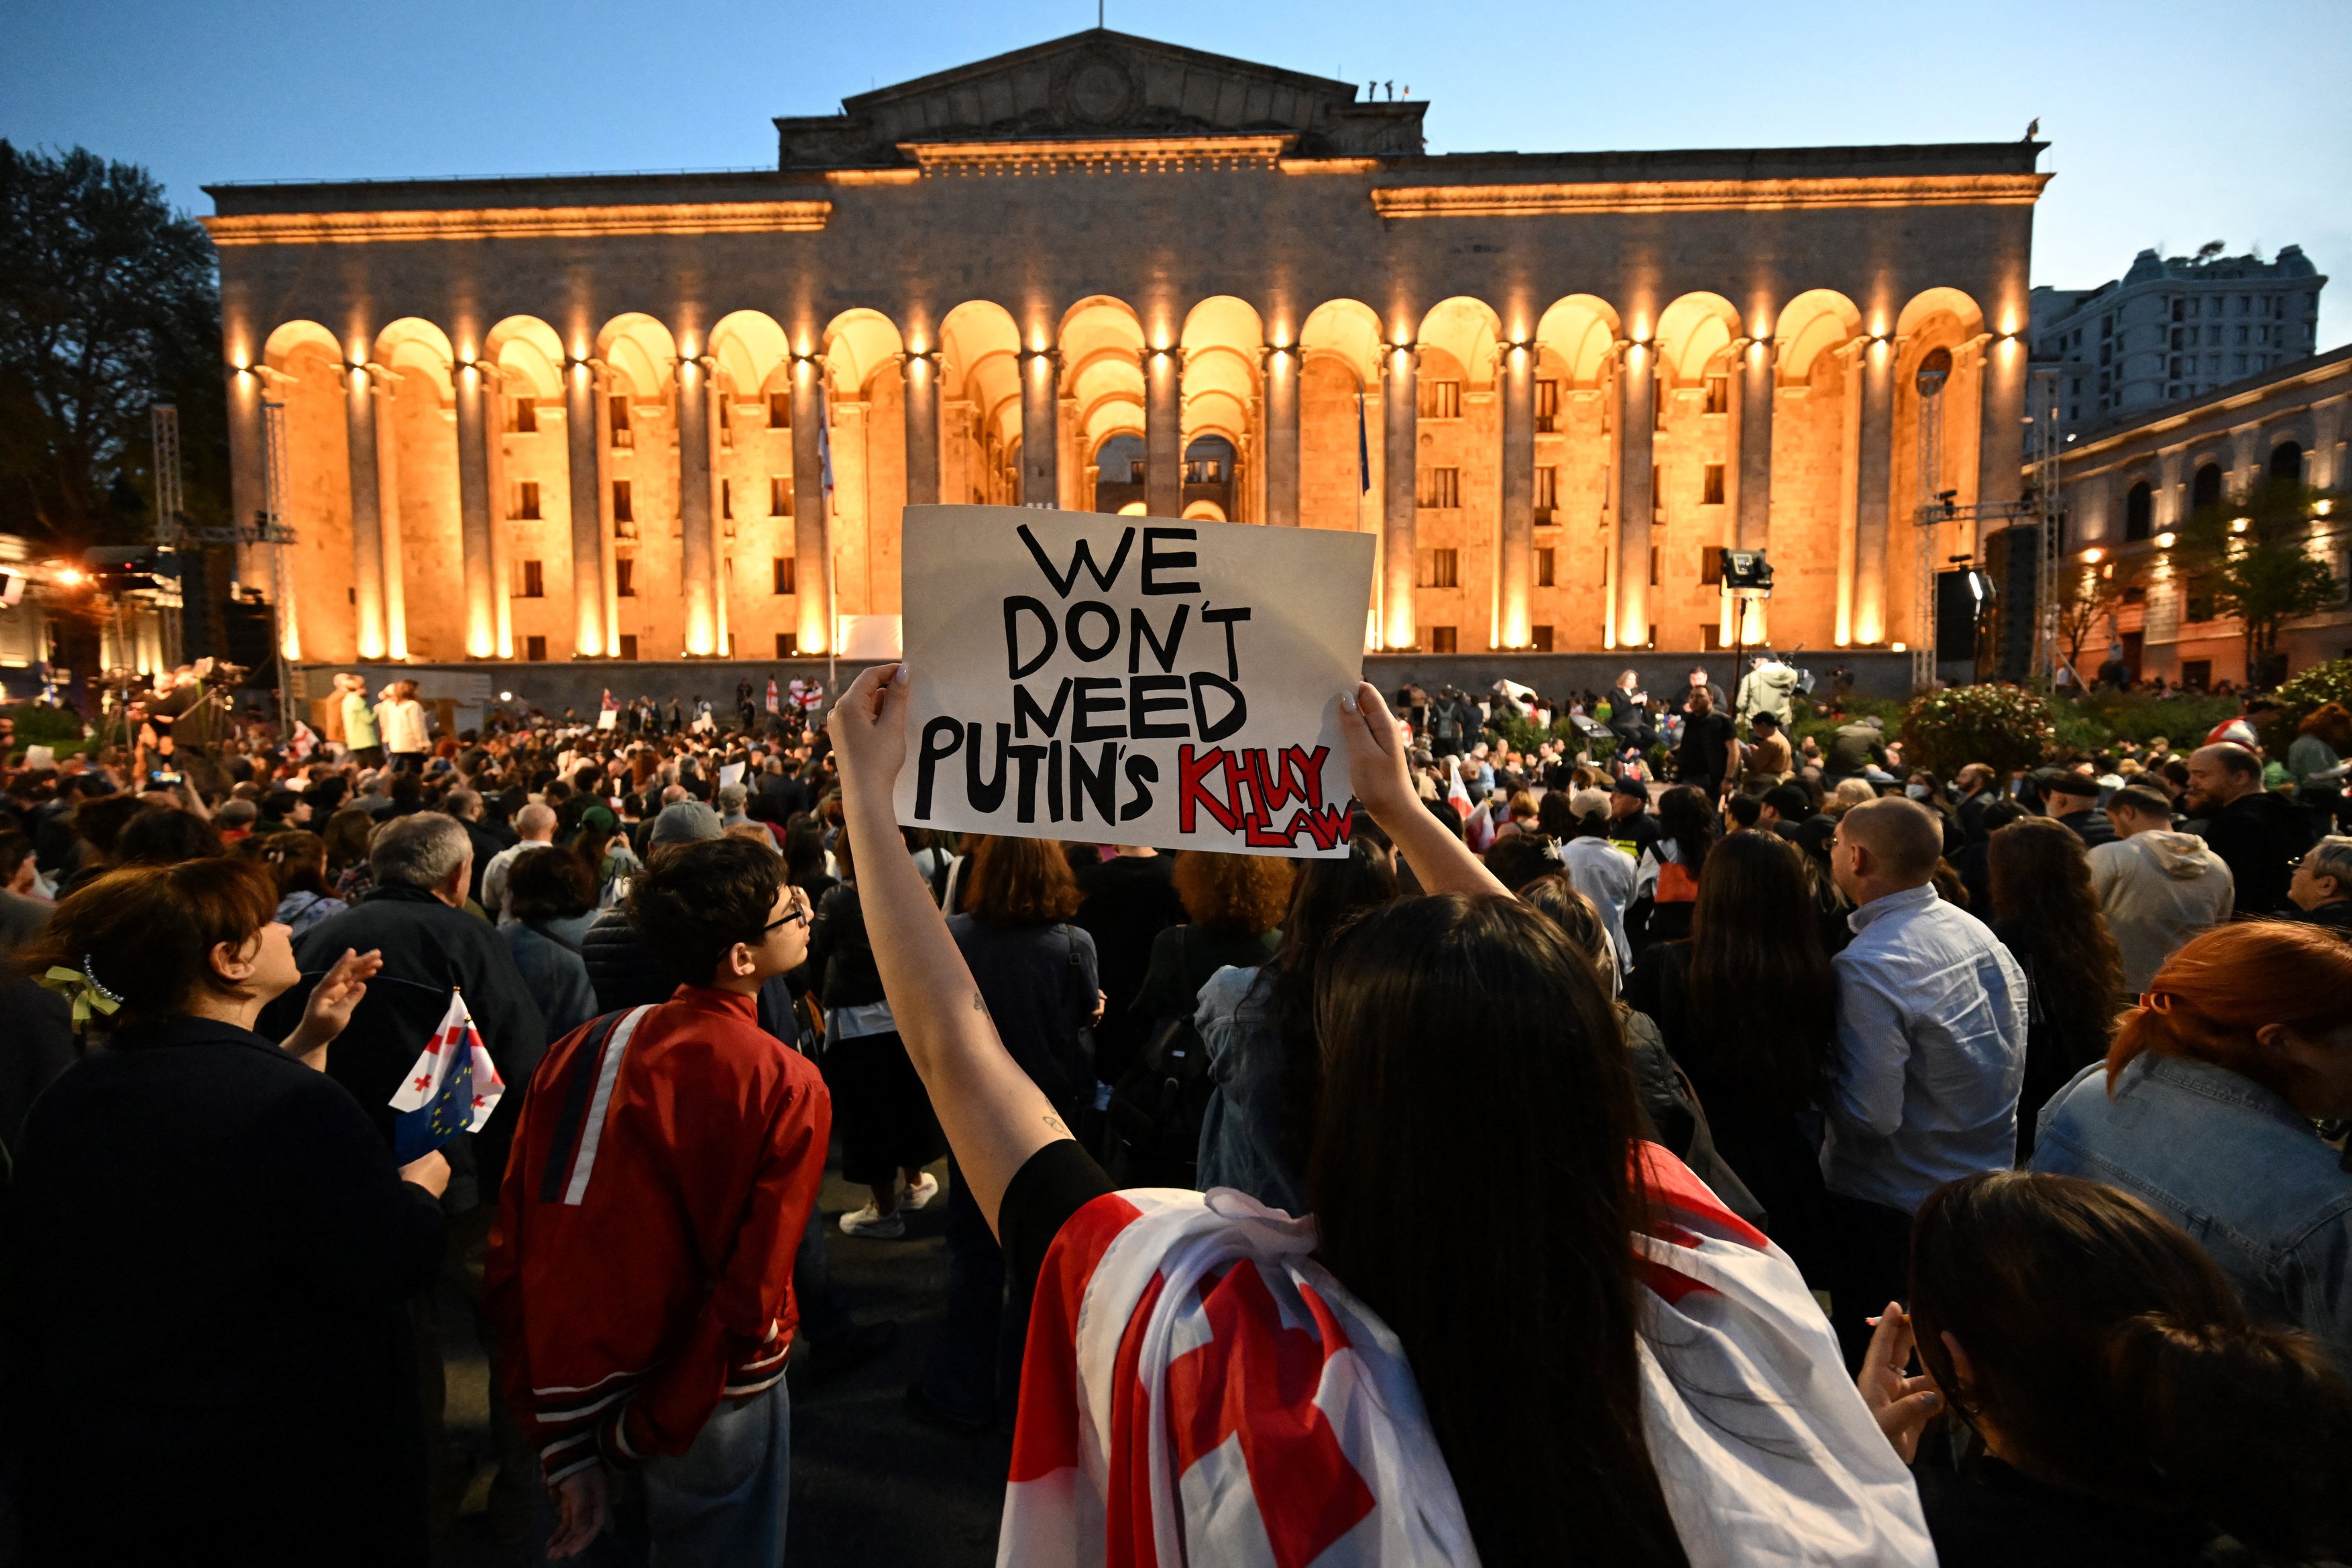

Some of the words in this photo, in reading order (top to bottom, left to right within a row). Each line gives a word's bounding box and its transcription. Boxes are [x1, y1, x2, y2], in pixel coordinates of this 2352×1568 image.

[1016, 524, 1201, 599] WE
[1003, 596, 1251, 682] DON'T
[1013, 672, 1247, 743] NEED
[914, 716, 1159, 826] PUTIN'S
[1178, 743, 1331, 834] KHUY
[1245, 800, 1352, 850] LAW
